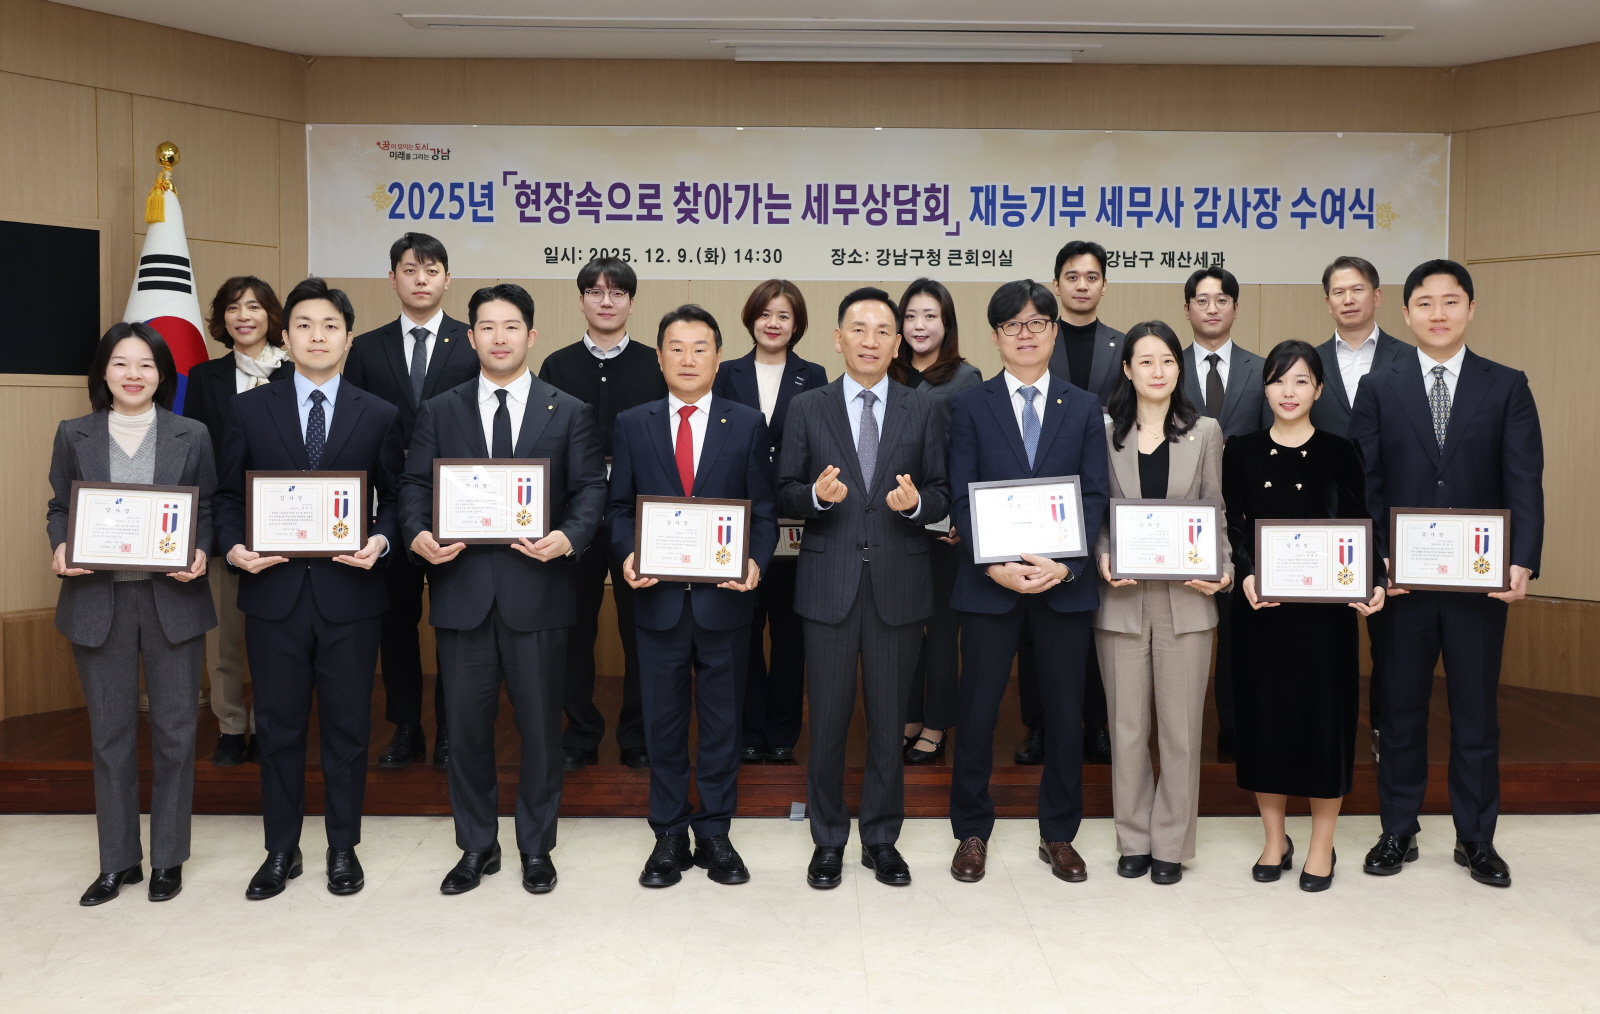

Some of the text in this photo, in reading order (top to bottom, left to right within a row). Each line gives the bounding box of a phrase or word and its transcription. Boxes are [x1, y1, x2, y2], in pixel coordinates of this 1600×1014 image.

[389, 148, 452, 161] 미래를 그리는 강남
[397, 143, 414, 151] 모이는
[414, 143, 429, 151] 도시
[387, 170, 1376, 236] 2025년 「현장속으로 찾아가는 세무상담회」 재능기부 세무사 감사장 수여식
[543, 246, 583, 265] 일시:
[734, 248, 783, 264] 14:30
[830, 248, 1013, 267] 장소: 강남구청 큰회의실
[1106, 250, 1226, 269] 강남구 재산세과
